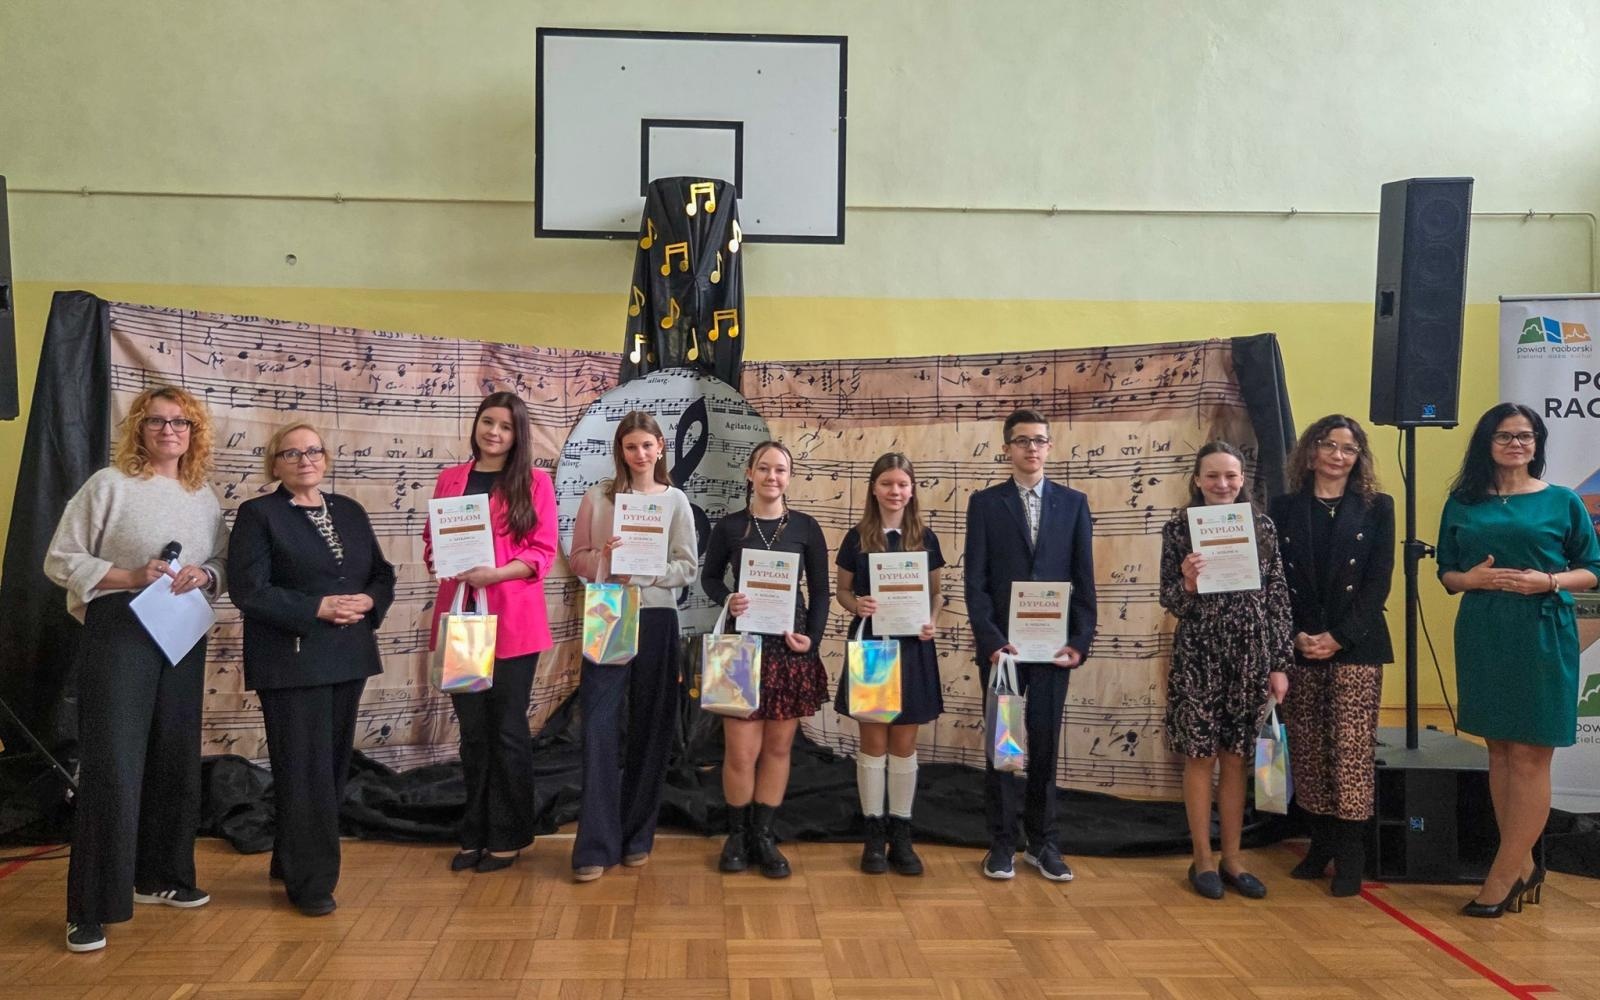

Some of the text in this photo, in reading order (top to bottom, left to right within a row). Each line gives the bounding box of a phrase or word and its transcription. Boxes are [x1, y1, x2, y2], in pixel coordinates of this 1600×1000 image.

[1516, 345, 1592, 354] powiat raciborski
[1545, 397, 1600, 418] RAC
[440, 514, 481, 524] DYPLOM
[623, 513, 662, 522] DYPLOM
[1200, 525, 1244, 535] DYPLOM
[749, 569, 789, 579] DYPLOM
[879, 572, 919, 580] DYPLOM
[1019, 600, 1059, 608] DYPLOM
